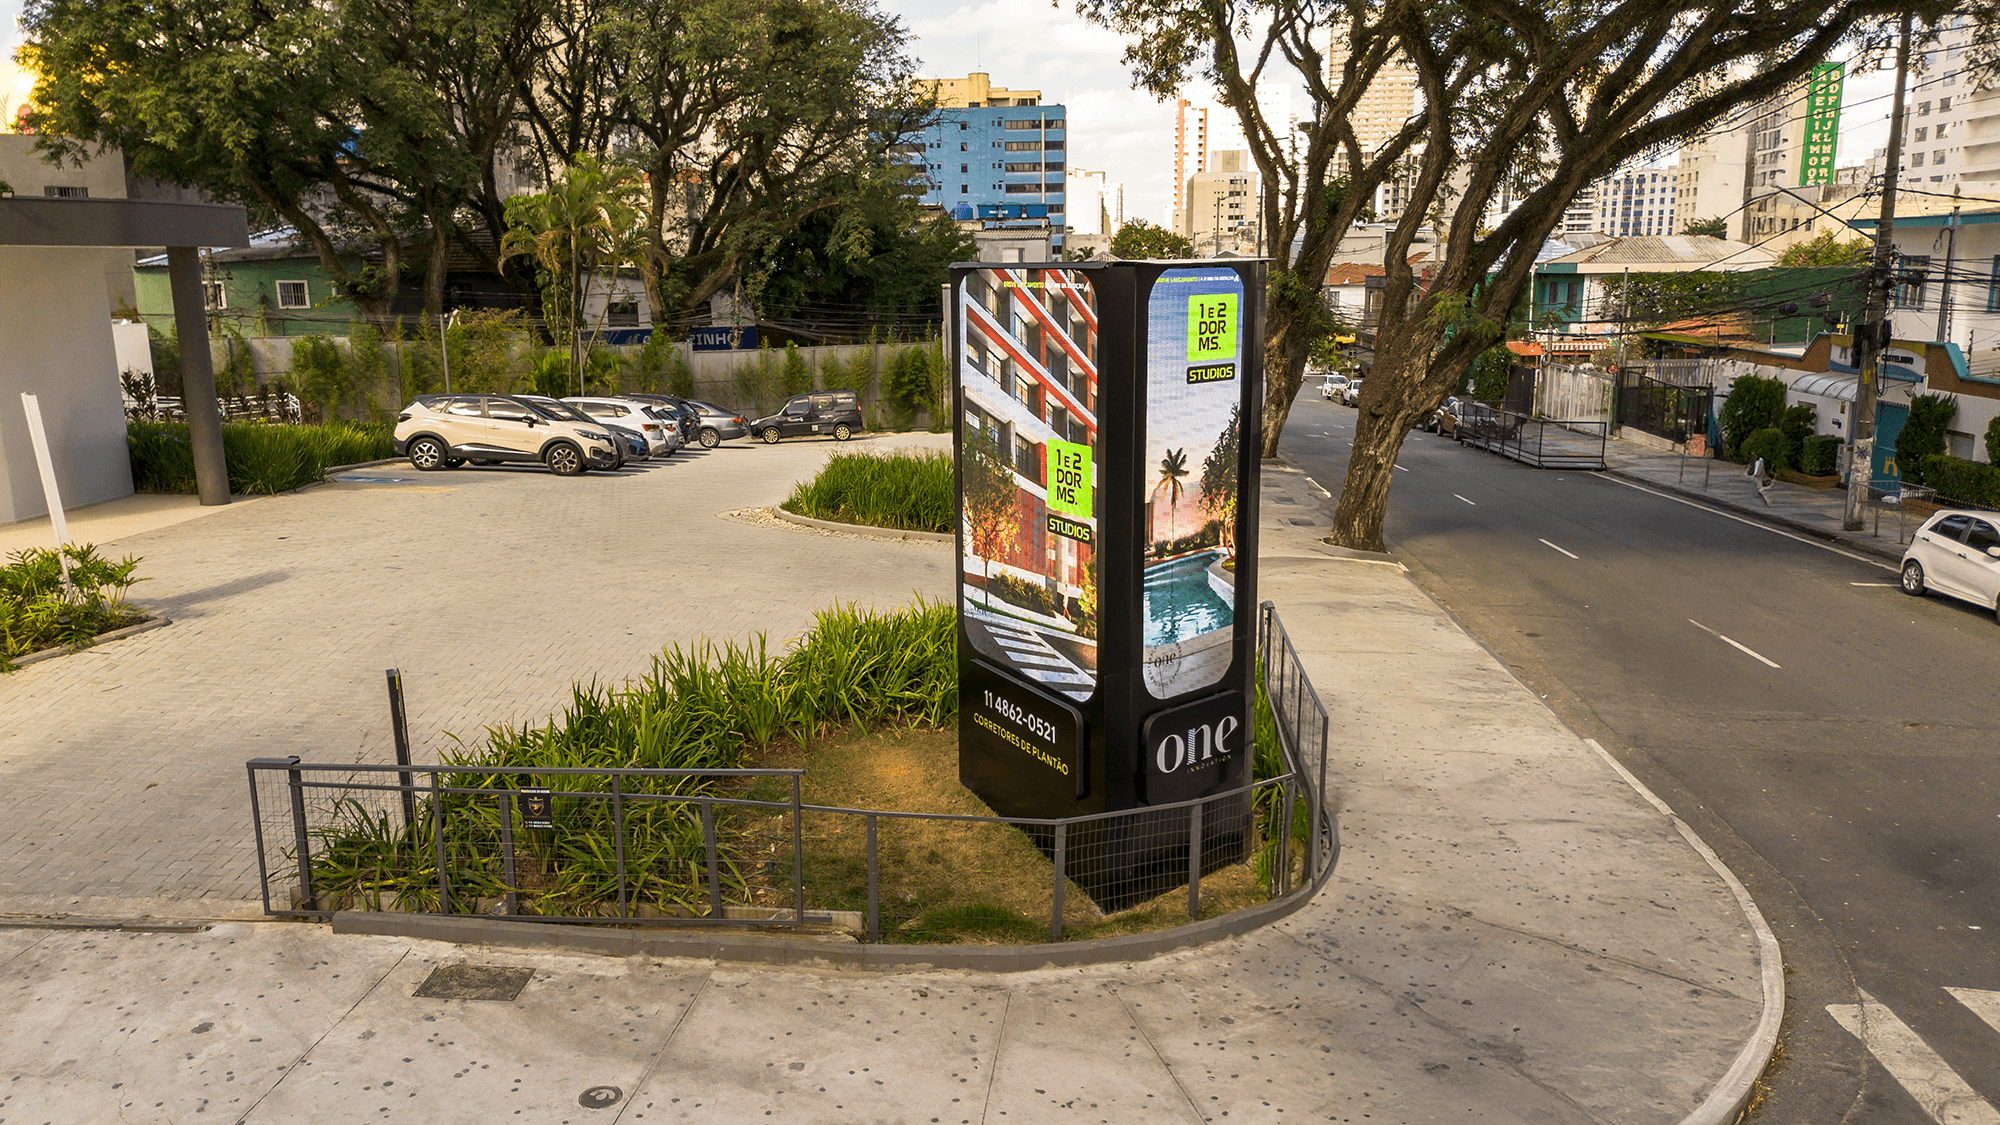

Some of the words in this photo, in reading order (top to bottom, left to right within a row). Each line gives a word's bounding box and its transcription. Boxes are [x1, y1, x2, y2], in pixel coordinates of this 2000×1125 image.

[1199, 303, 1204, 319] 1
[1208, 307, 1214, 318] E
[1217, 302, 1226, 317] 2
[1198, 320, 1226, 335] DOR
[1198, 336, 1221, 351] MS.
[1189, 366, 1233, 381] STUDIOS
[1056, 449, 1061, 466] 1
[1064, 456, 1070, 468] E
[1073, 452, 1081, 470] 2
[1056, 468, 1082, 489] DOR
[1056, 486, 1077, 505] MS.
[1049, 518, 1089, 541] STUDIOS
[984, 690, 993, 709] 11
[995, 696, 1055, 744] 4862-0521
[973, 712, 1020, 747] CORRETORES
[1020, 739, 1031, 754] DE
[1032, 745, 1069, 775] PLANTÃO
[1156, 715, 1238, 774] one
[1186, 754, 1231, 774] INNOVATION
